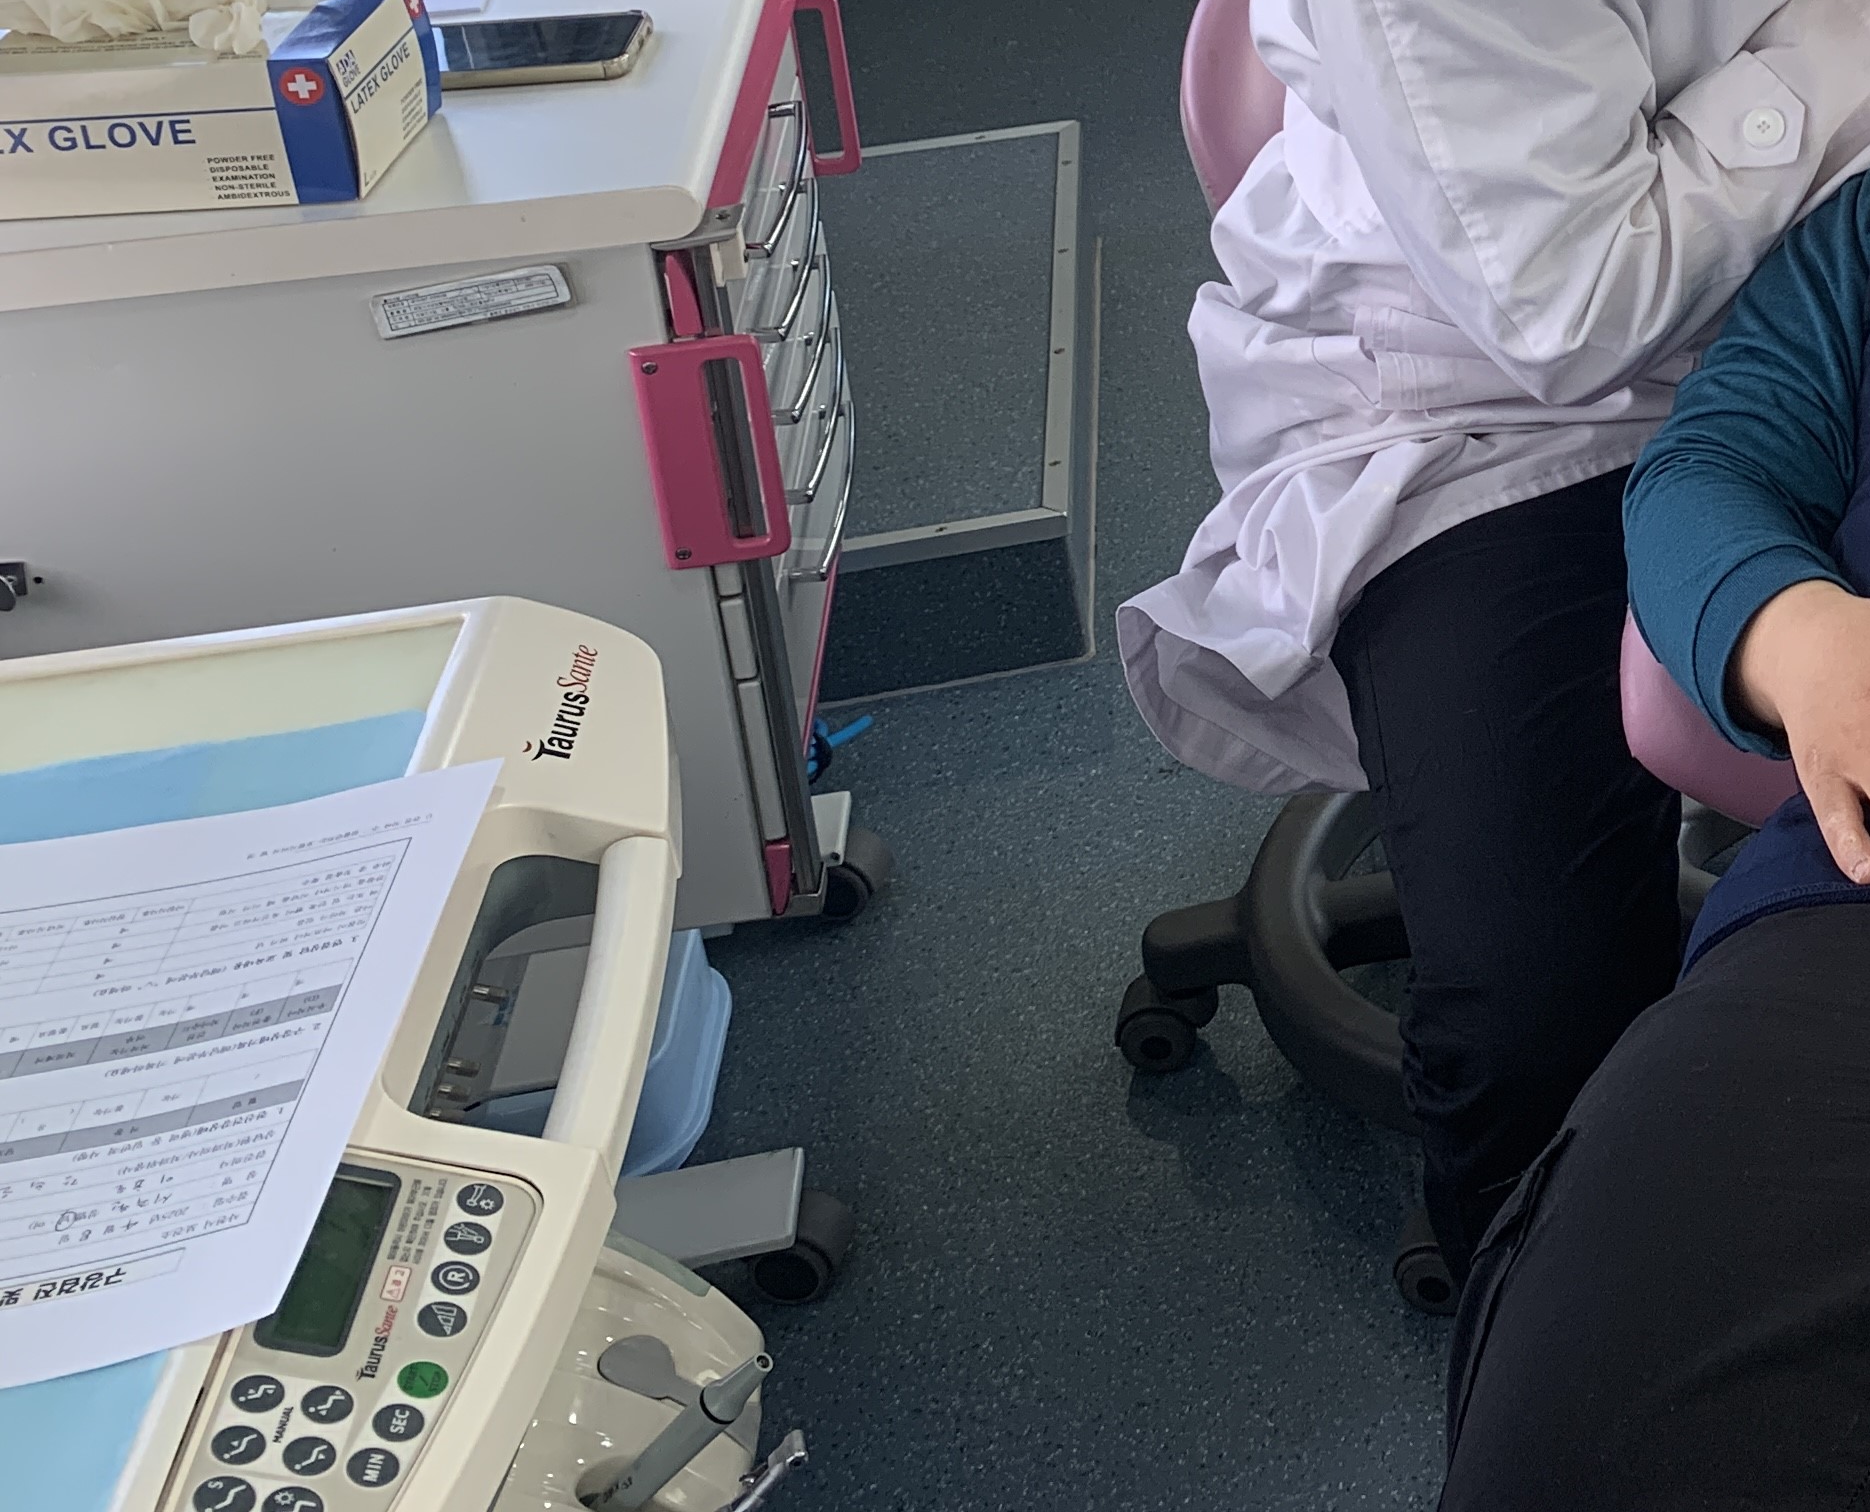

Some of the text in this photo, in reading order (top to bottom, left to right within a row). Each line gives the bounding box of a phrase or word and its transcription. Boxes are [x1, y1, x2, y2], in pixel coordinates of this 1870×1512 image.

[350, 40, 411, 115] LATEX GLOVE
[48, 118, 196, 152] GLOVE
[206, 153, 275, 164] POWDER FREE
[209, 163, 269, 173] DISPOSABLE
[211, 172, 276, 183] EXAMINATION
[214, 181, 277, 191] NON-STERILE
[216, 190, 291, 200] AMBIDEXTROUS
[33, 1268, 126, 1301] 구강검진
[272, 1406, 295, 1444] MANUAL
[389, 1409, 411, 1434] SEC
[362, 1453, 386, 1483] MIN
